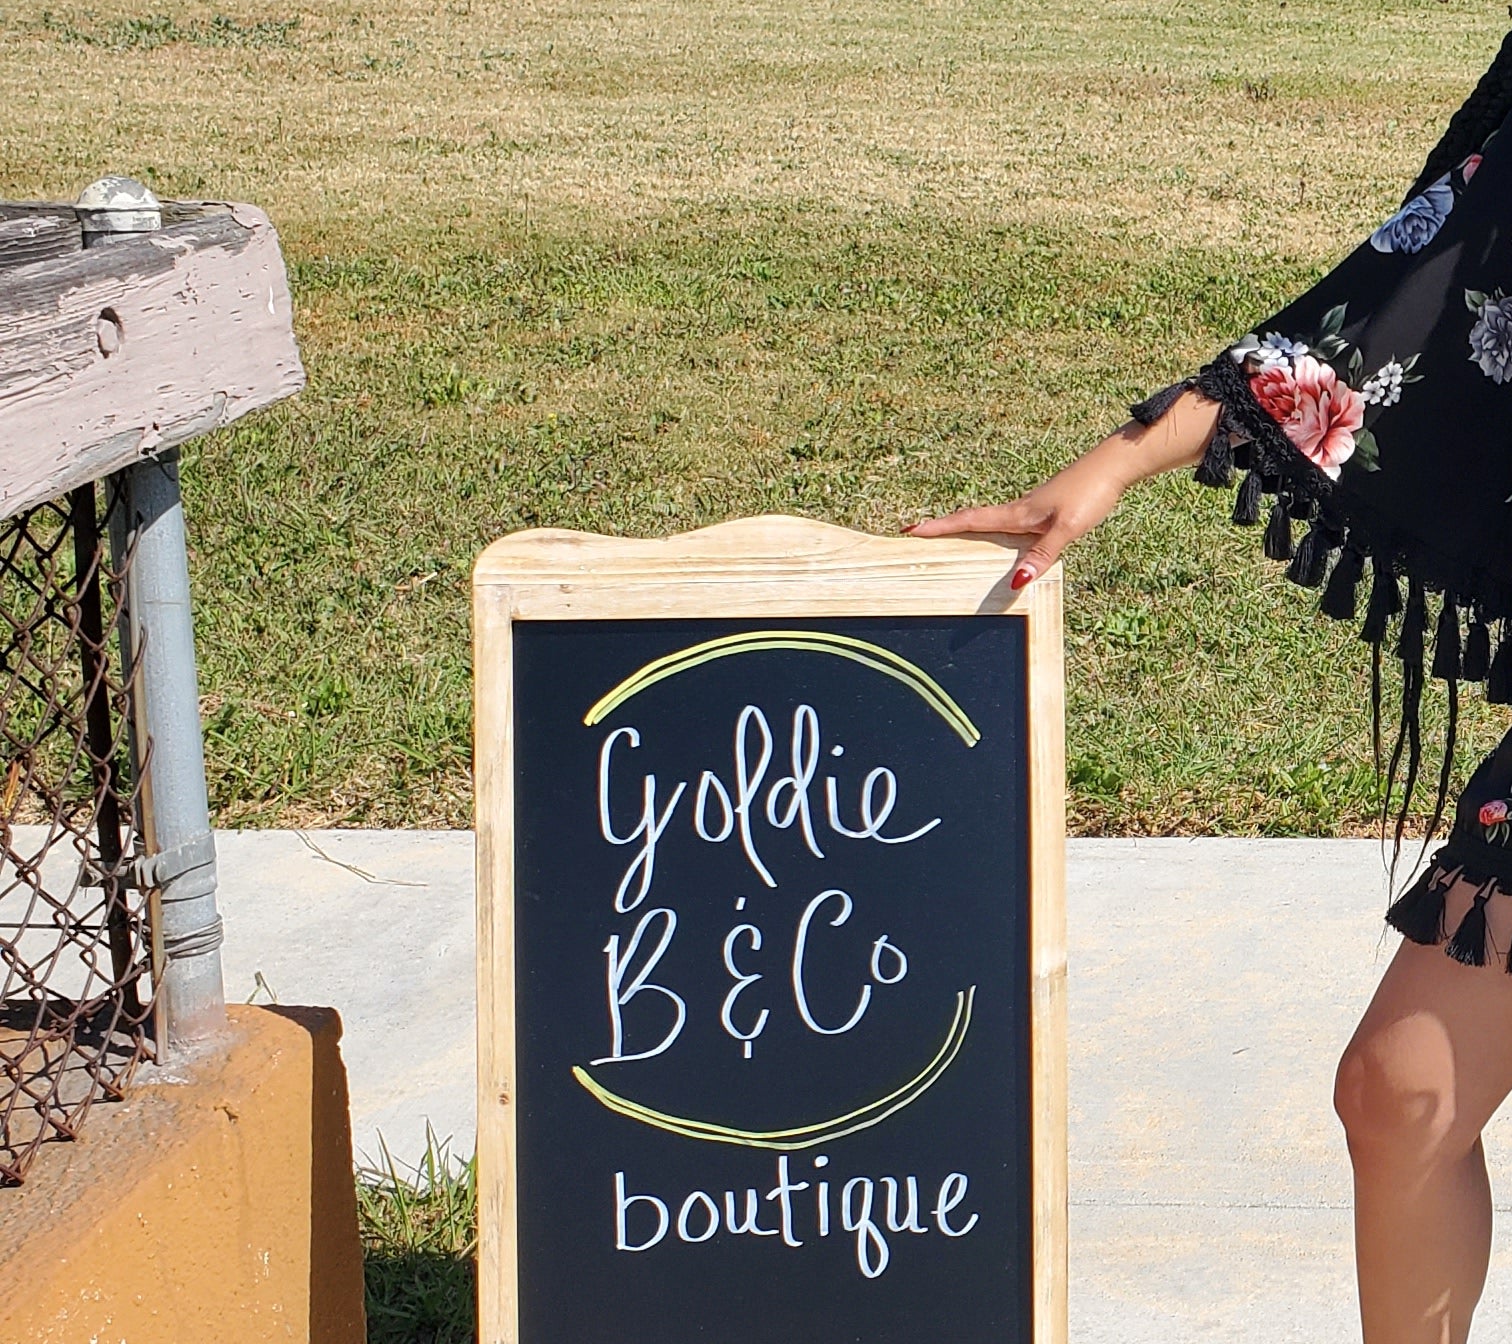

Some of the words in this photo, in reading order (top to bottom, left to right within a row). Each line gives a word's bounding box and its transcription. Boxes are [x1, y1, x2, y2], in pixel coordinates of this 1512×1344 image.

[599, 703, 943, 914] Goldie
[589, 907, 687, 1066] B
[721, 895, 771, 1060] &
[791, 888, 909, 1036] Co
[614, 1154, 980, 1280] boutique
